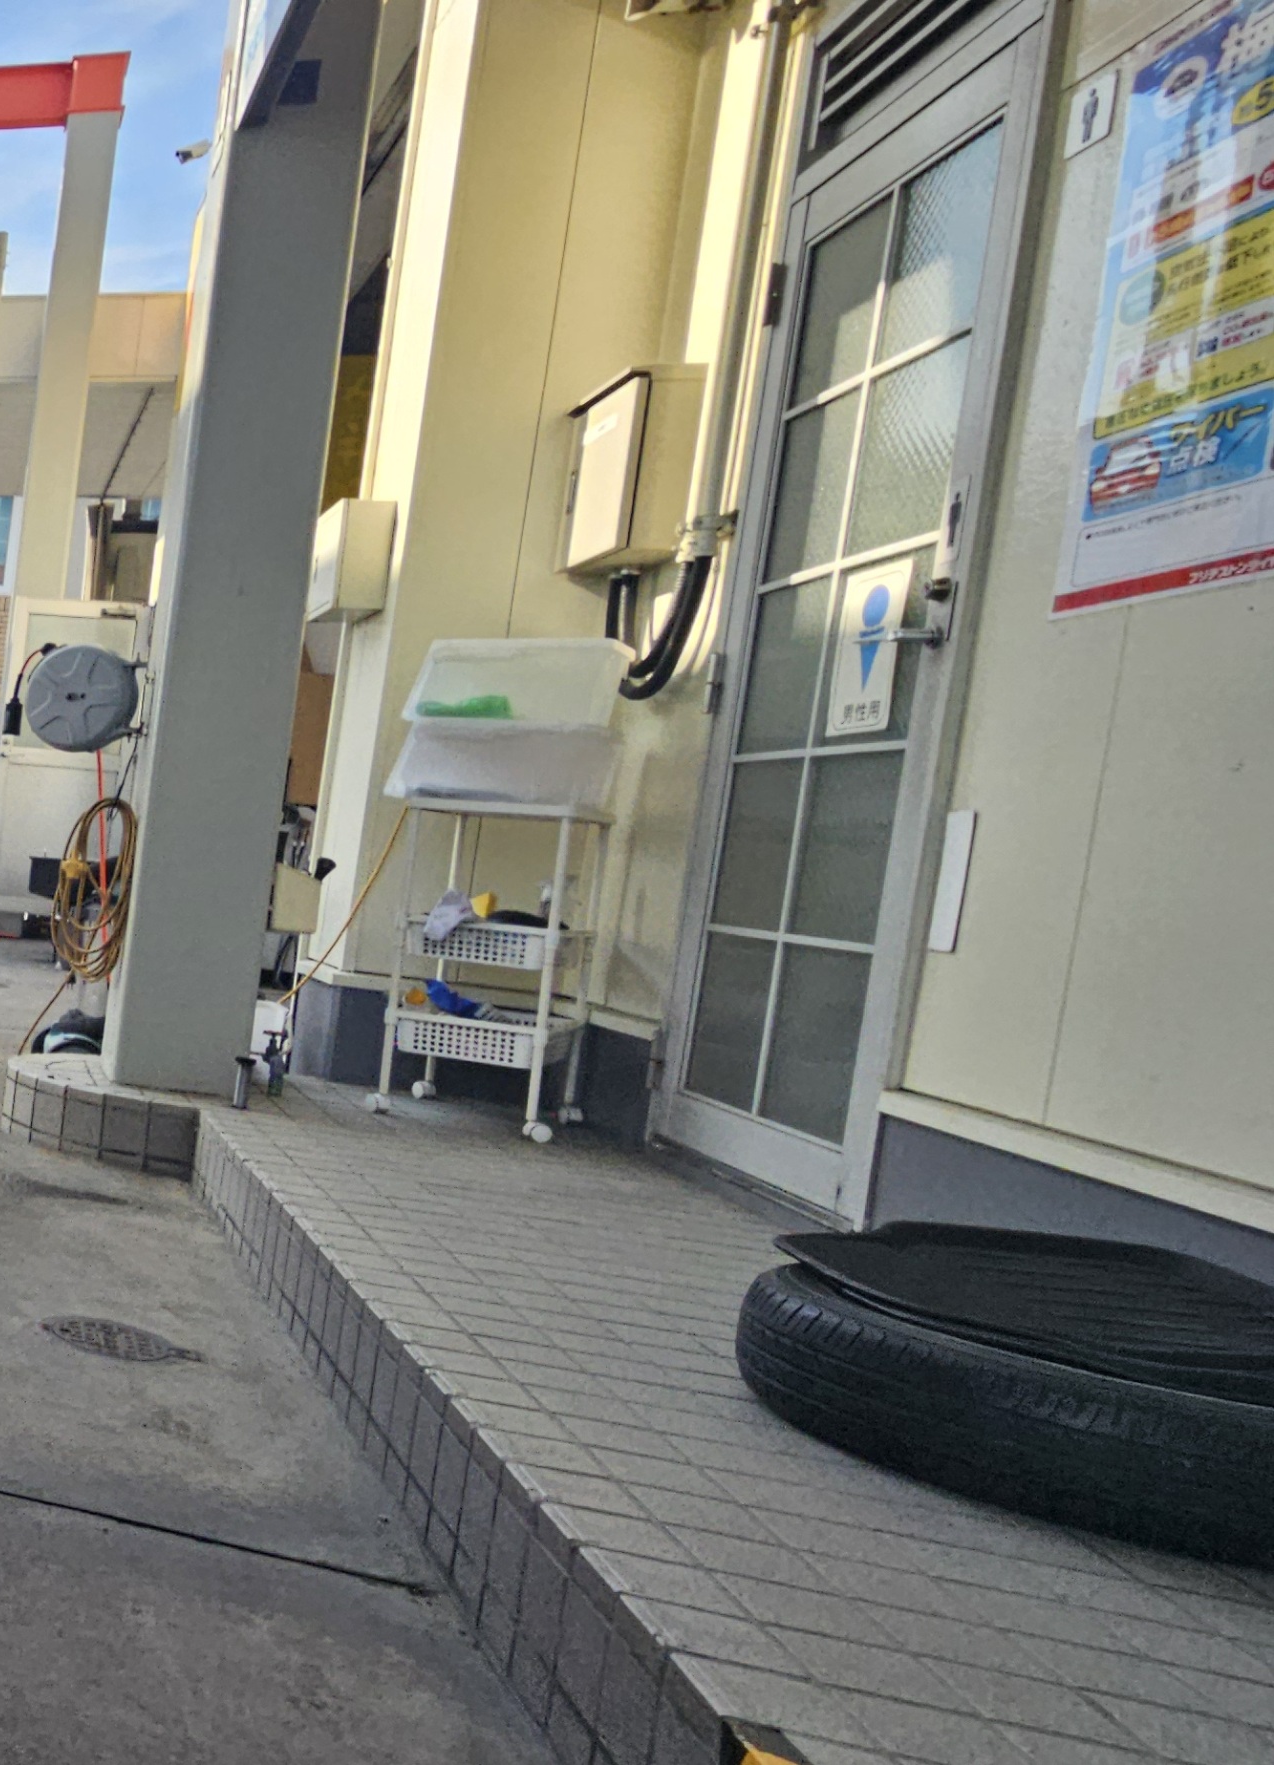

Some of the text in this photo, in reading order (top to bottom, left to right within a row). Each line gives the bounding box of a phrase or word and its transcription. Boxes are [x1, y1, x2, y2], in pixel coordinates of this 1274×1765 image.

[1170, 404, 1267, 446] ワイパー
[1165, 436, 1221, 477] 点検
[841, 701, 881, 726] 男性用
